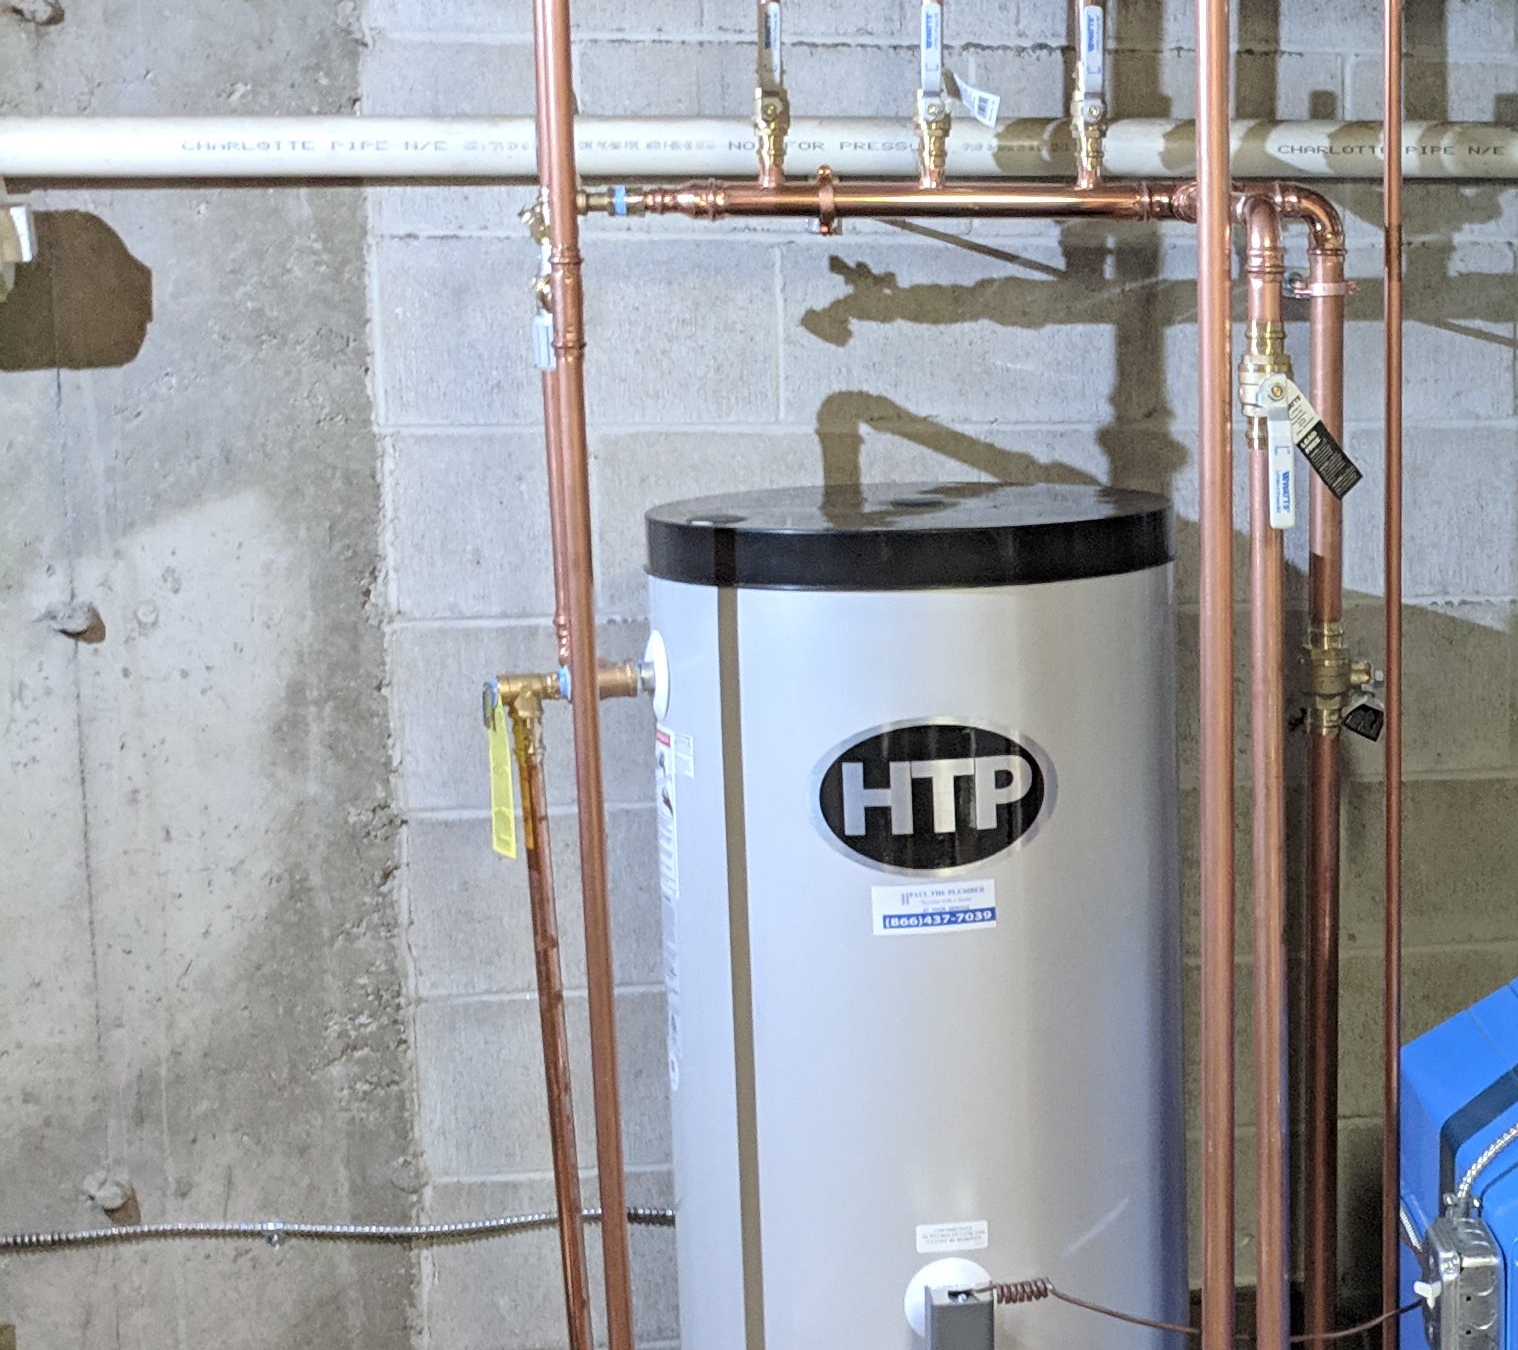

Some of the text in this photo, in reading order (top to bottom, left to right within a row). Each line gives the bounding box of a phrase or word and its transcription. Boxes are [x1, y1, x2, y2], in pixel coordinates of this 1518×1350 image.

[182, 140, 315, 152] CHARLOTTE
[331, 140, 390, 152] PIPE
[1277, 144, 1385, 155] CHARLOTT
[1405, 145, 1455, 156] PIPE
[1282, 470, 1291, 513] WATTS
[841, 753, 1034, 837] HTP
[947, 886, 985, 896] PLUMBER
[885, 910, 993, 929] (866)437-7039
